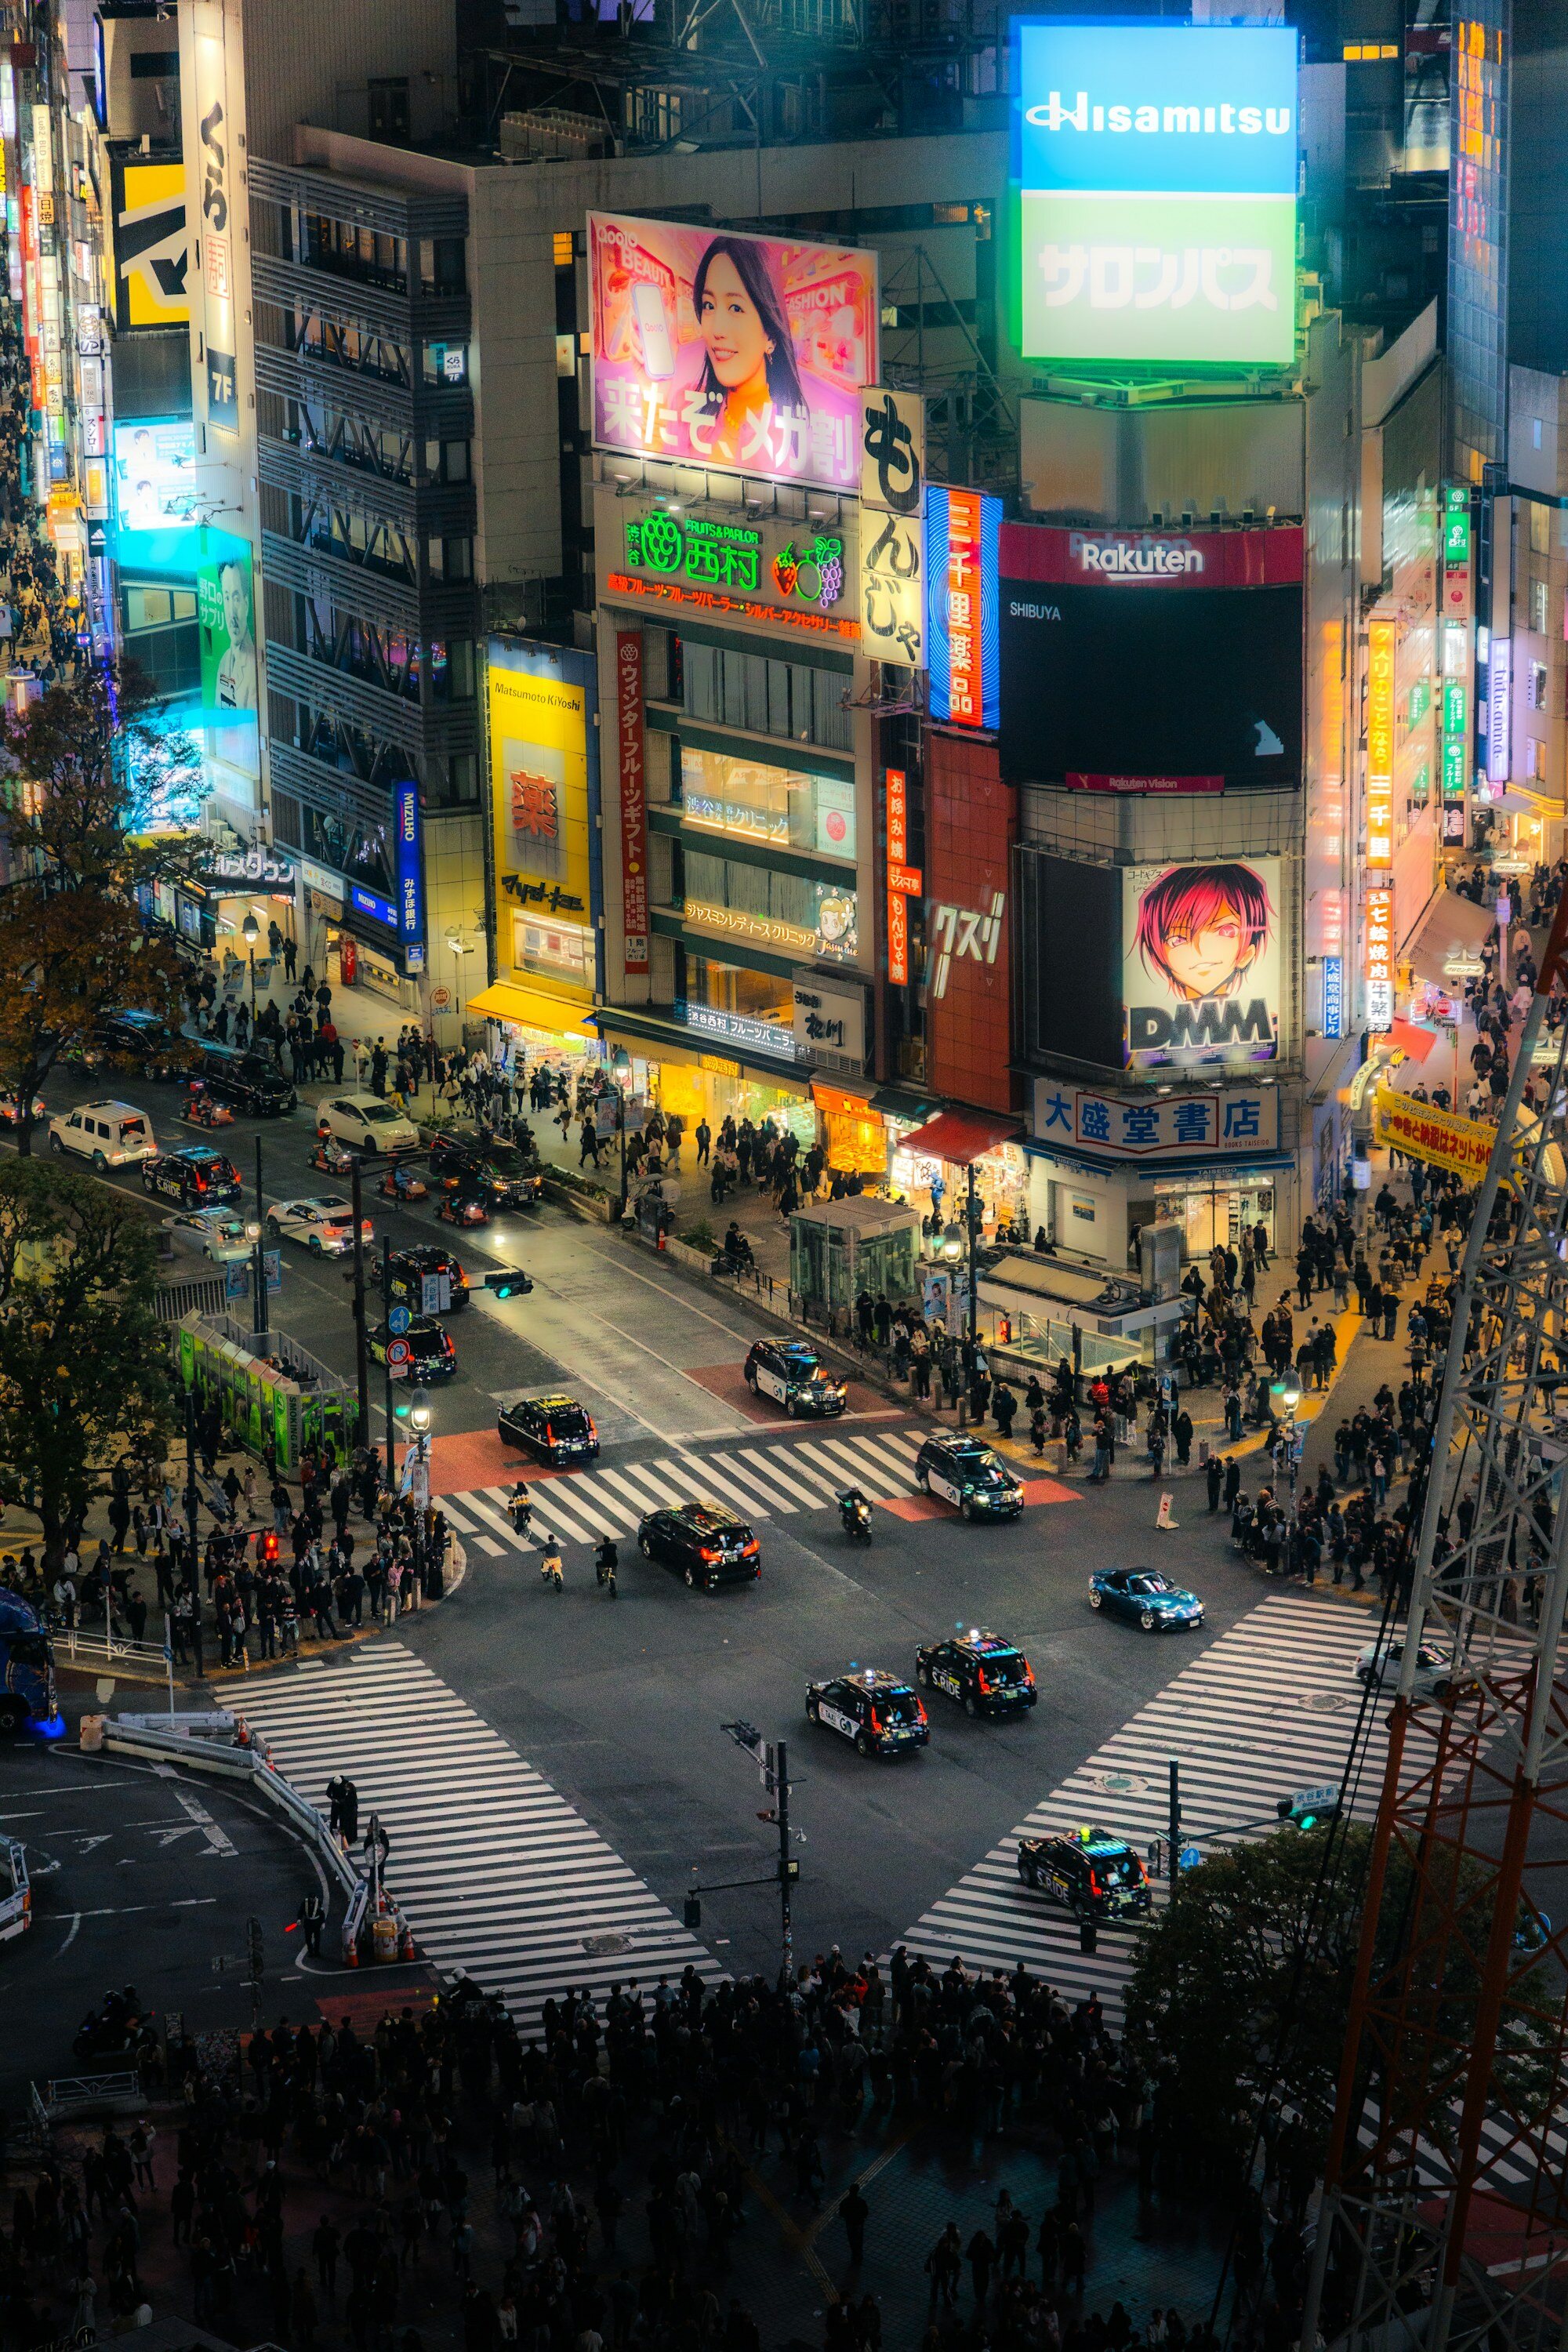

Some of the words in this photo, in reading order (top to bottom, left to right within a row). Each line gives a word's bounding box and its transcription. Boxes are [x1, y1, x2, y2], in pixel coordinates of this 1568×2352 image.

[1025, 91, 1290, 135] Hisamitsu
[1038, 243, 1278, 312] サロンパス
[212, 370, 232, 404] 7F
[86, 419, 97, 453] スシロー
[864, 393, 922, 662] もんじゃ
[684, 537, 758, 590] 西村
[1082, 543, 1203, 573] Rakuten
[200, 605, 225, 632] サプリ
[1010, 601, 1062, 621] SHIBUYA
[495, 682, 546, 703] Matsumoto
[547, 694, 581, 712] KiYoshi
[621, 666, 641, 860] ウィンターフルーツギフト
[1109, 777, 1147, 789] Rakuten
[1148, 779, 1178, 789] Vision
[404, 792, 416, 842] MIZUHO
[510, 768, 559, 840] 薬
[890, 775, 904, 859] お好み焼
[1448, 808, 1464, 837] HUB
[358, 892, 376, 909] MIZUHO
[404, 878, 416, 931] みずほ銀行
[686, 903, 771, 938] ジャスミンレディース
[771, 925, 816, 947] クリニック
[891, 895, 905, 981] もんじゃ焼
[816, 938, 858, 957] Jasmine
[1327, 961, 1340, 1035] 大盛堂商事ビル
[691, 1011, 727, 1029] 渋谷西村
[730, 1021, 796, 1047] フルーツパーラー
[1128, 997, 1276, 1052] DMM
[1045, 1092, 1261, 1144] 大盛堂書店
[1053, 1156, 1082, 1169] TAISEIDO
[1224, 1140, 1243, 1149] BOOKS
[1244, 1138, 1270, 1148] TAISEIDO
[1197, 1167, 1237, 1175] TAISEIDO
[289, 1396, 299, 1443] SMOKING
[290, 1443, 299, 1468] AREA
